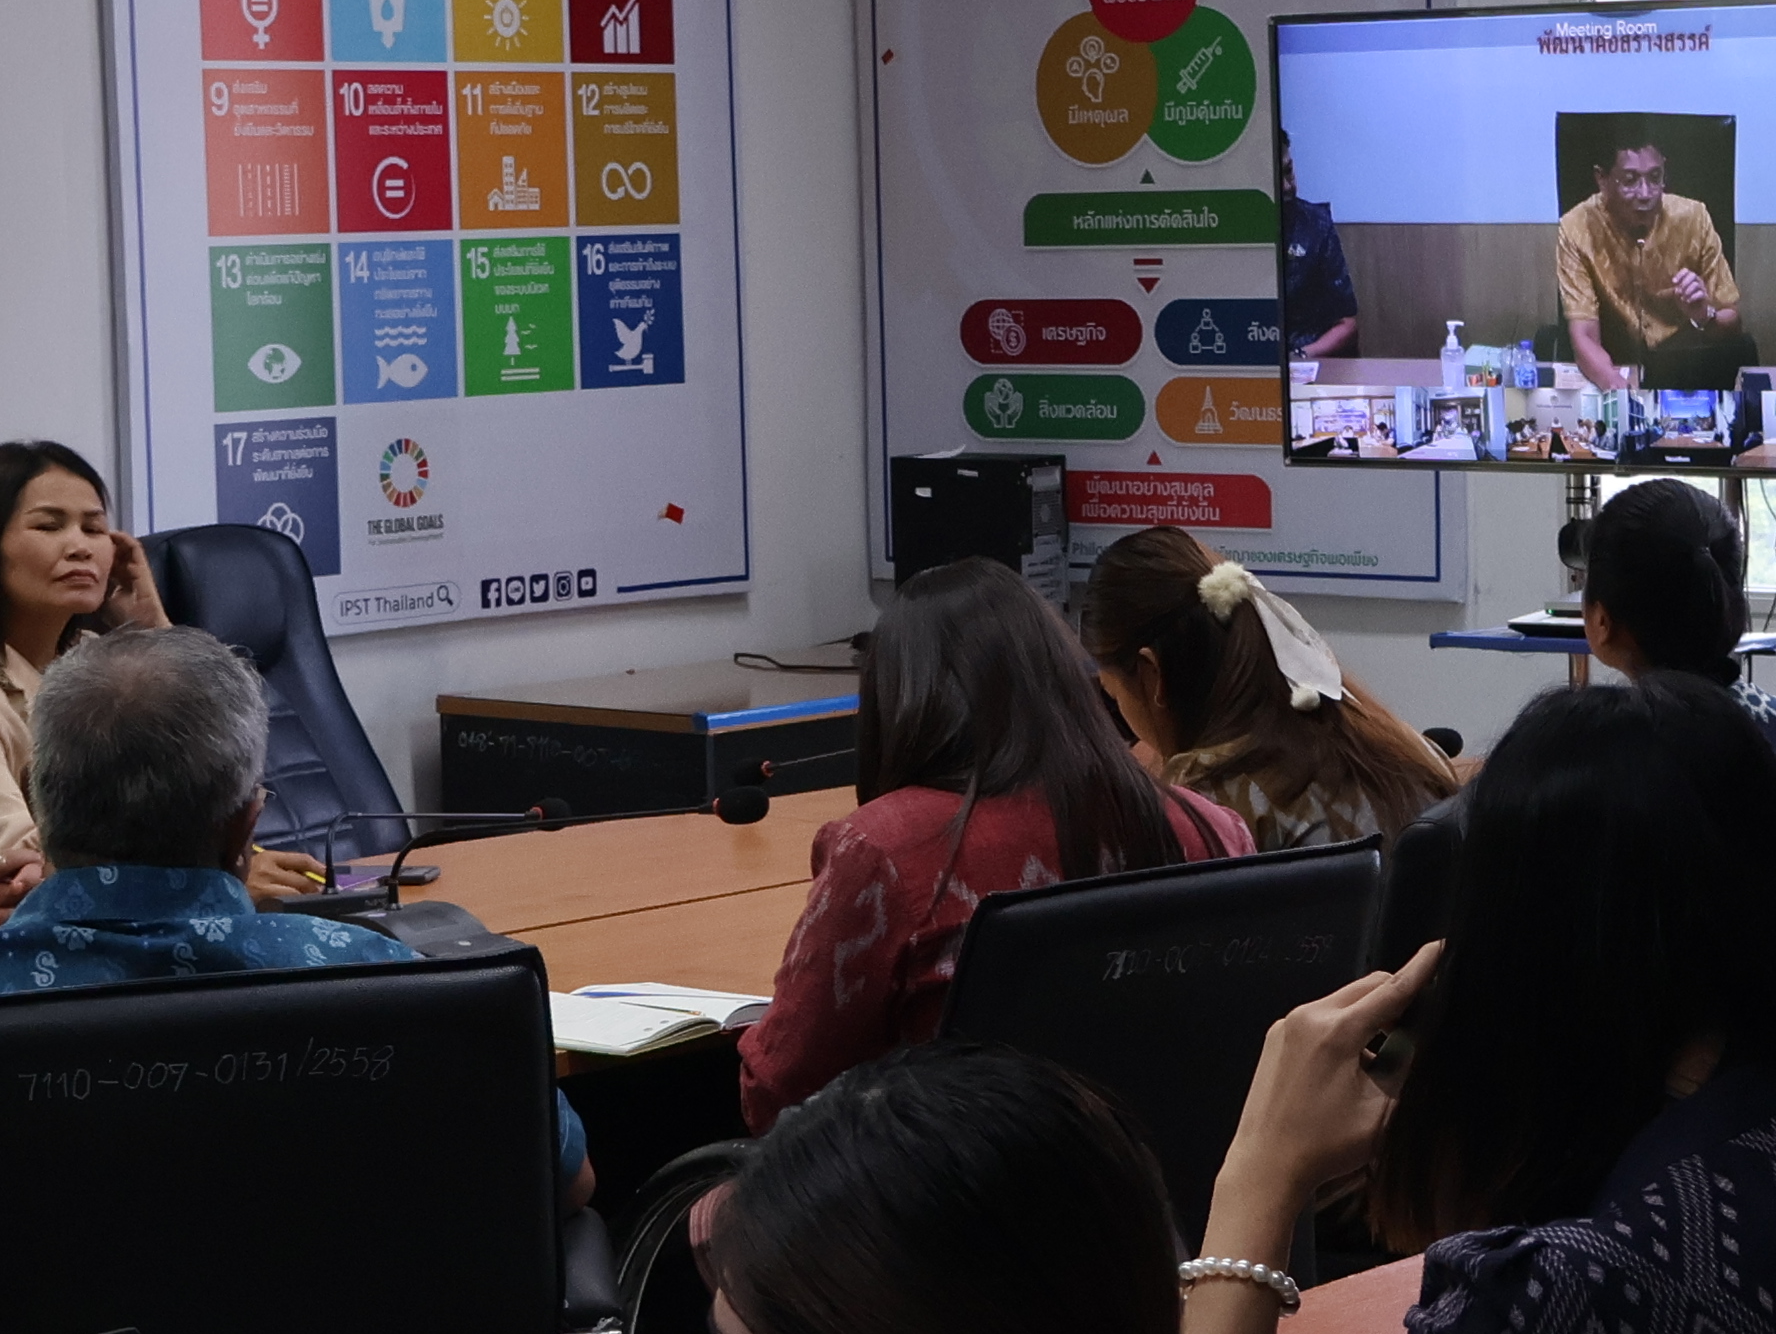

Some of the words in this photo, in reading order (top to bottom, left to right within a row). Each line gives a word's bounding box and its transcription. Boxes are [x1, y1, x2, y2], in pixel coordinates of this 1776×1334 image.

[1555, 22, 1613, 39] Meeting
[1616, 21, 1658, 36] Room
[210, 81, 230, 117] 9
[339, 81, 366, 117] 10
[461, 83, 484, 116] 11
[577, 83, 602, 117] 12
[1072, 205, 1220, 233] หลักแห่งการตัดสินใจ
[216, 254, 243, 290] 13
[345, 251, 370, 284] 14
[466, 247, 491, 280] 15
[581, 242, 606, 276] 16
[1040, 320, 1107, 348] เศรษฐกิจ
[1245, 319, 1280, 342] สังค
[1038, 393, 1118, 420] สิ่งแวดล้อม
[222, 431, 249, 467] 17
[1085, 475, 1215, 502] พัฒนาอย่างสมดุล
[339, 596, 370, 618] IPST
[374, 591, 435, 615] Thailand
